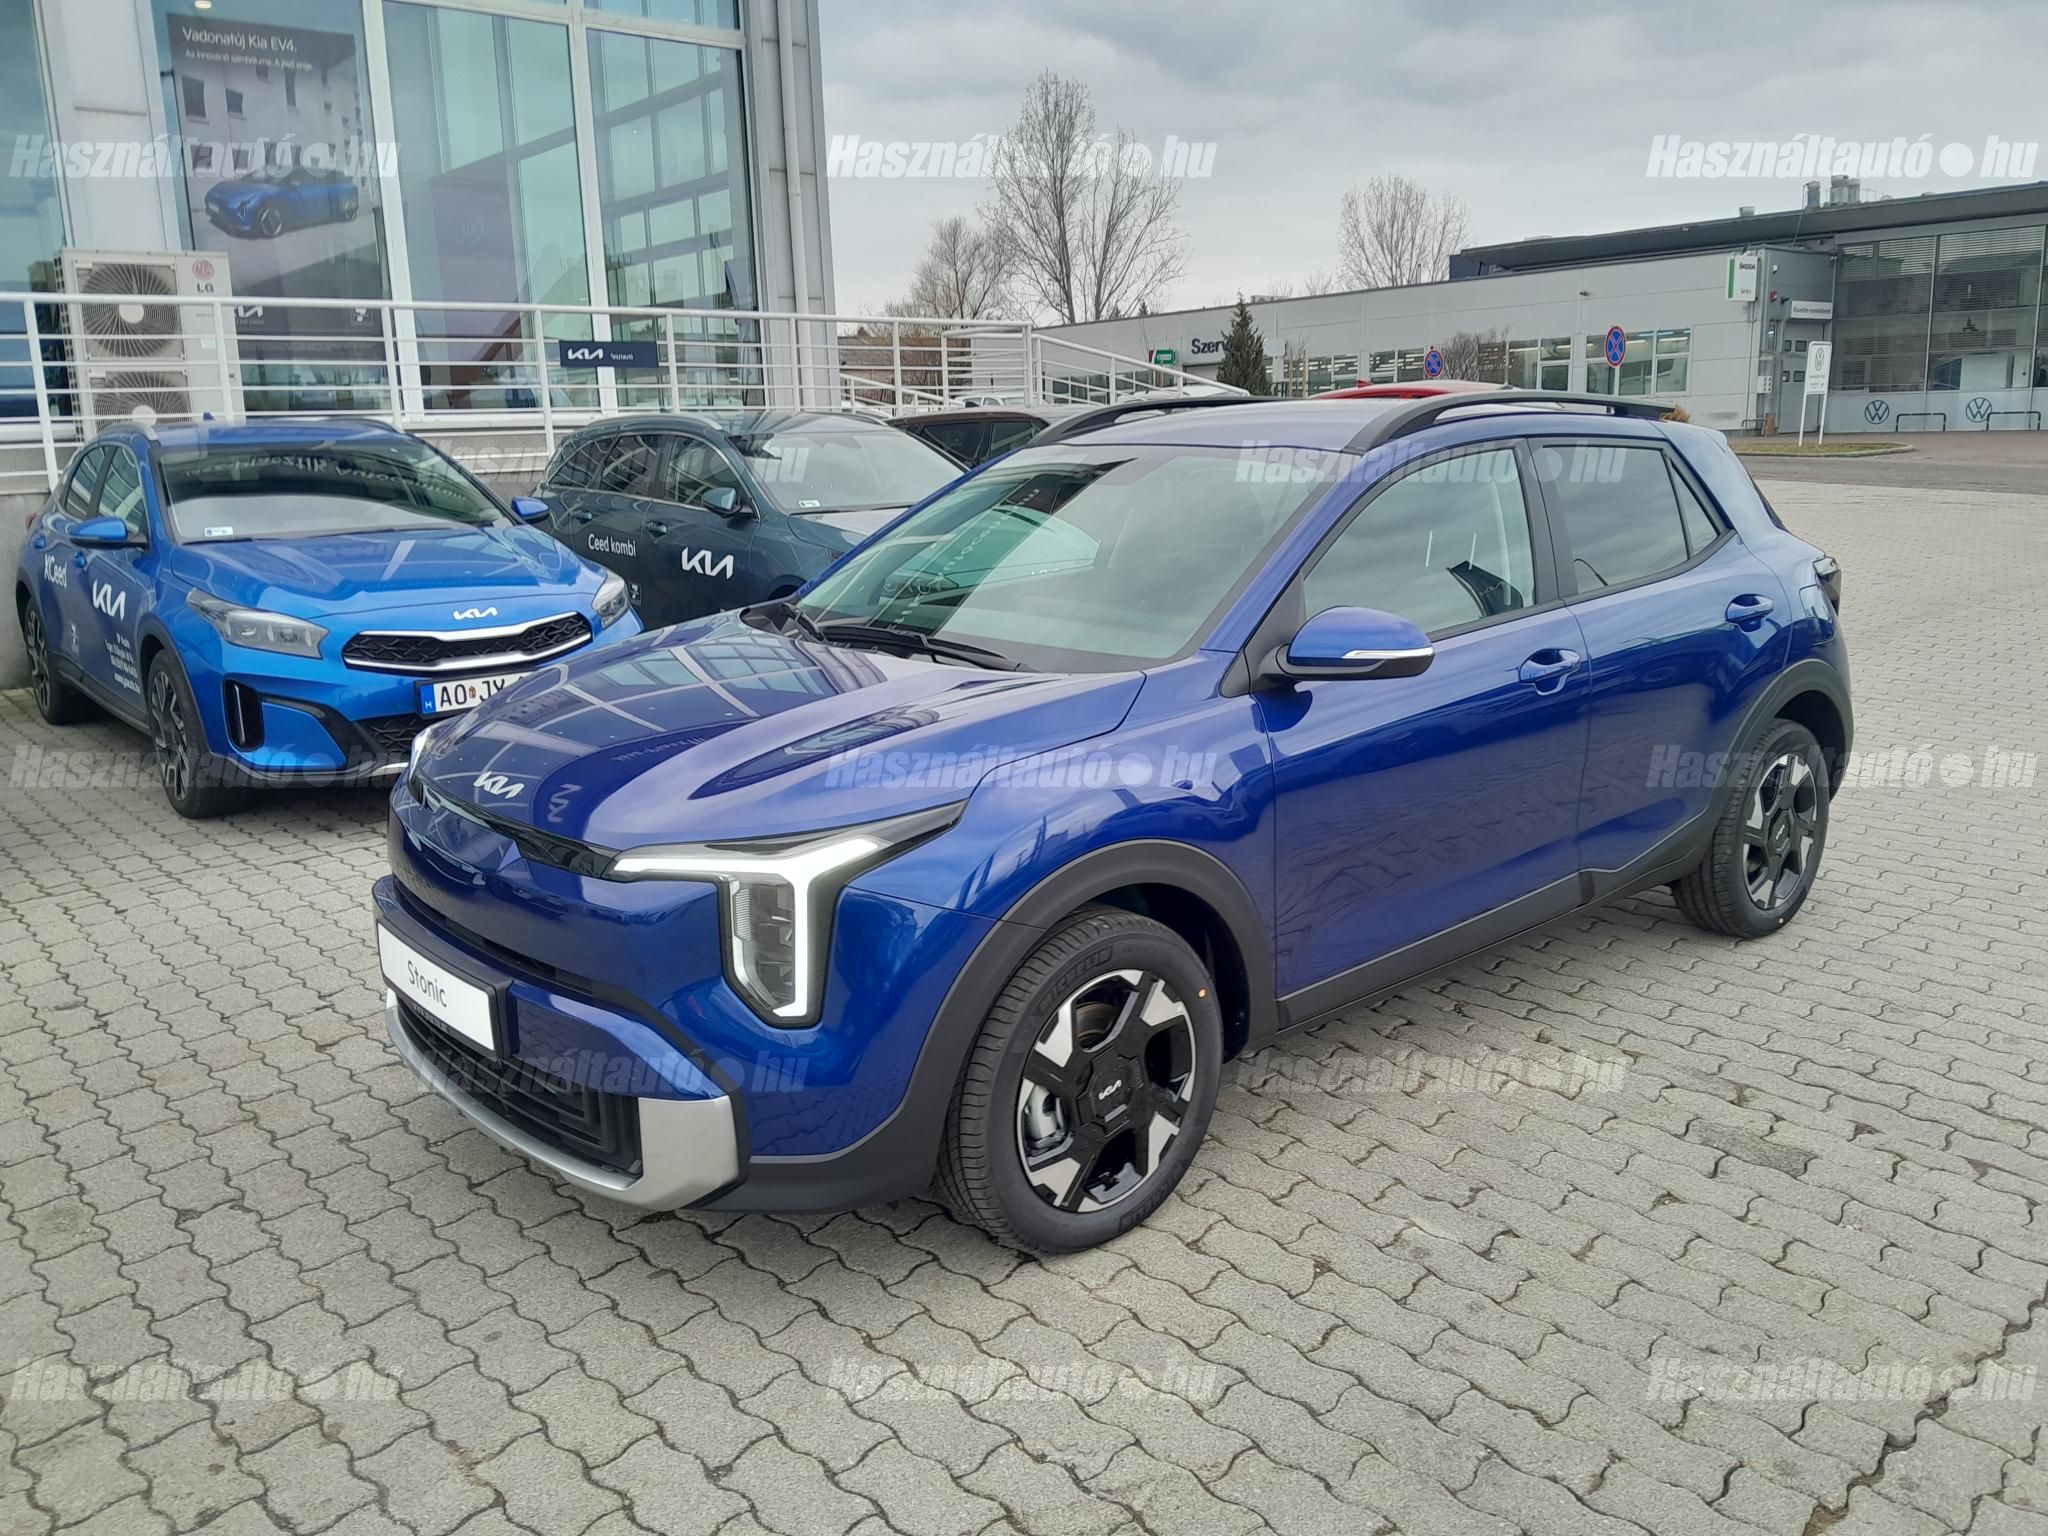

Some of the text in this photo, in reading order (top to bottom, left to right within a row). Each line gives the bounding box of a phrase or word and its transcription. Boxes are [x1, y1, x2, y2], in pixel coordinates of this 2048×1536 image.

[182, 26, 246, 50] Vadonatúj
[197, 283, 214, 293] LG
[567, 347, 604, 360] KIA
[588, 533, 637, 557] Ceed kombi
[44, 552, 67, 588] XCeed
[681, 547, 734, 580] KIA
[92, 579, 126, 621] KIA
[453, 606, 498, 620] KIA
[440, 684, 468, 708] AO
[472, 770, 525, 799] KIA
[407, 960, 448, 1008] Stonic
